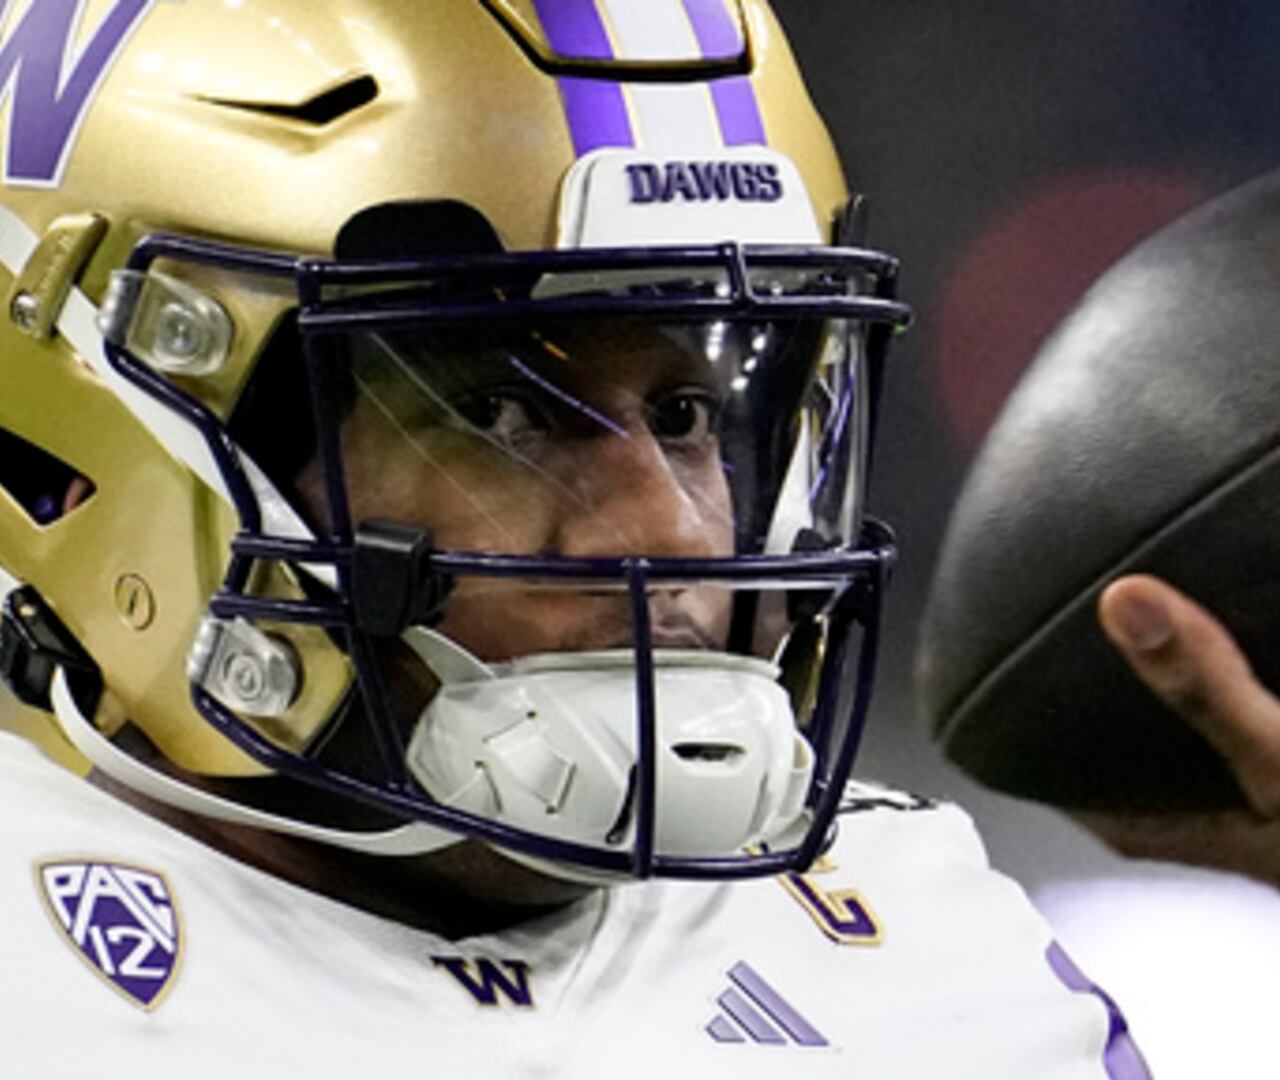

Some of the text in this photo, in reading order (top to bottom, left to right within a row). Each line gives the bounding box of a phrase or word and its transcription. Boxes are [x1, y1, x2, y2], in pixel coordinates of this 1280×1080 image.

[625, 160, 784, 204] DAWGS
[42, 863, 176, 954] PAC
[89, 923, 167, 979] 12
[428, 955, 534, 1007] W
